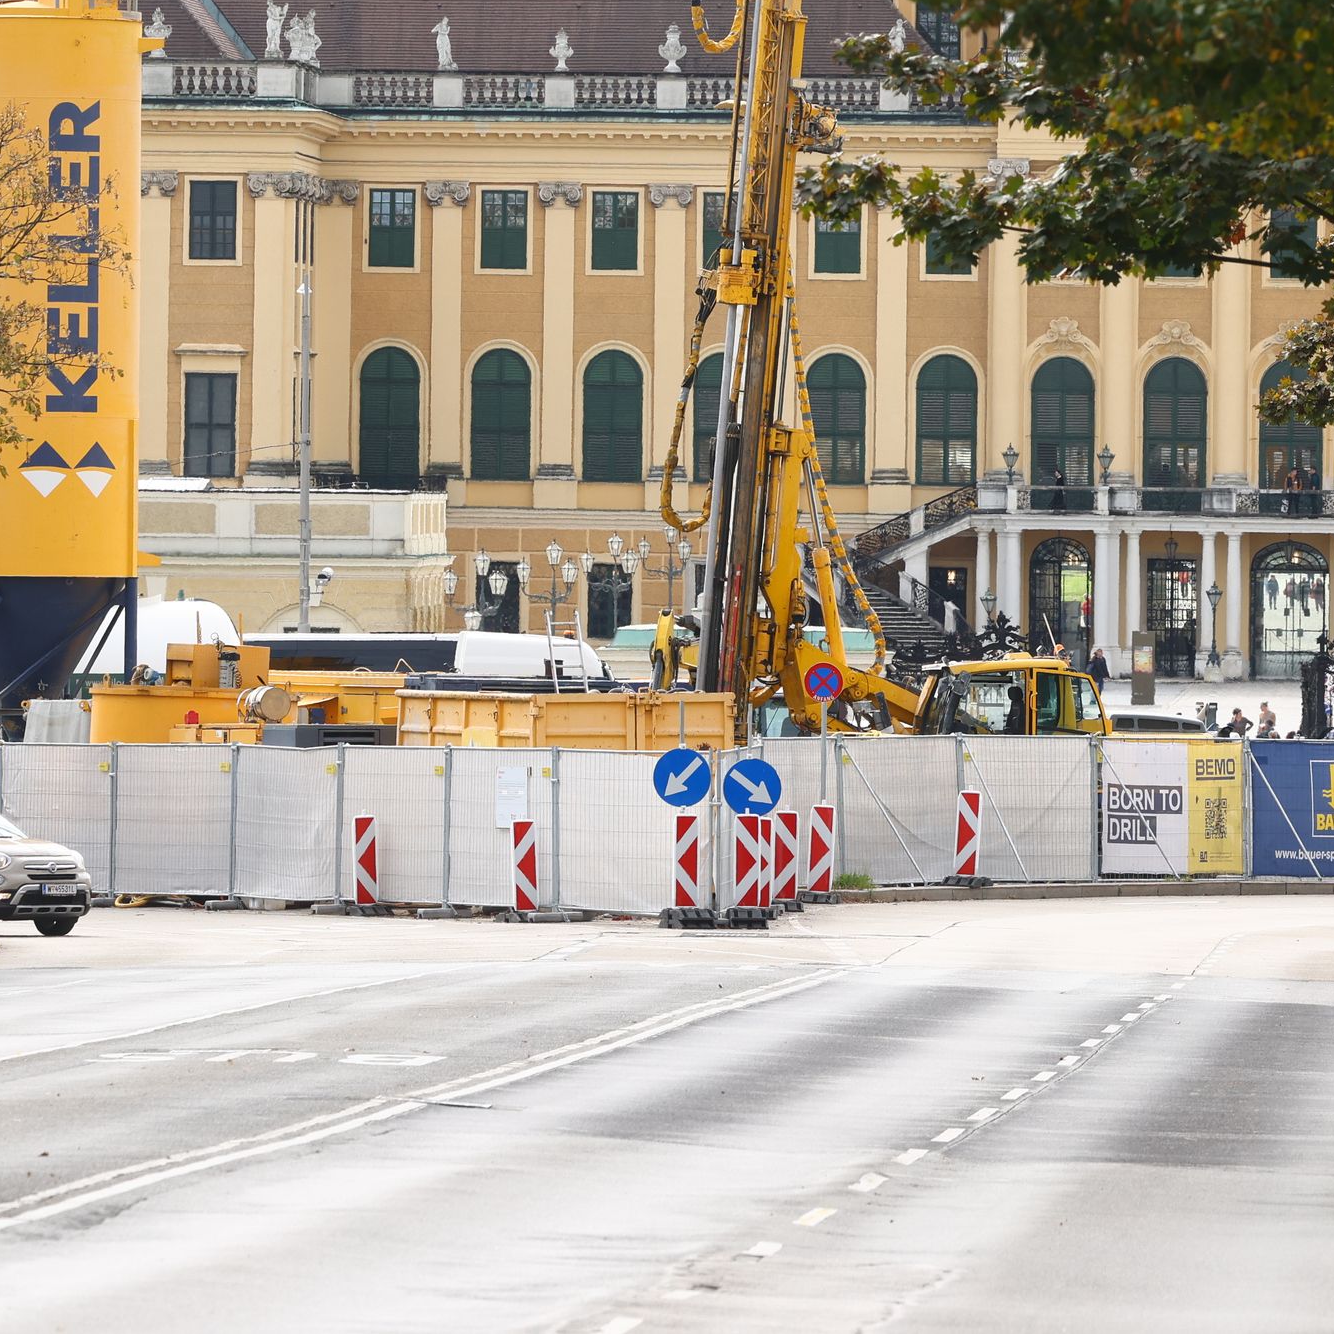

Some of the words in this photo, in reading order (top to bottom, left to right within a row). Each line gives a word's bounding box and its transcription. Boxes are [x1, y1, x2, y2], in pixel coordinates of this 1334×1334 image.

[46, 100, 101, 413] KELLER
[1196, 758, 1235, 775] BEMO
[1109, 787, 1155, 811] BORN
[1160, 789, 1181, 811] TO
[1109, 817, 1155, 841] DRILL
